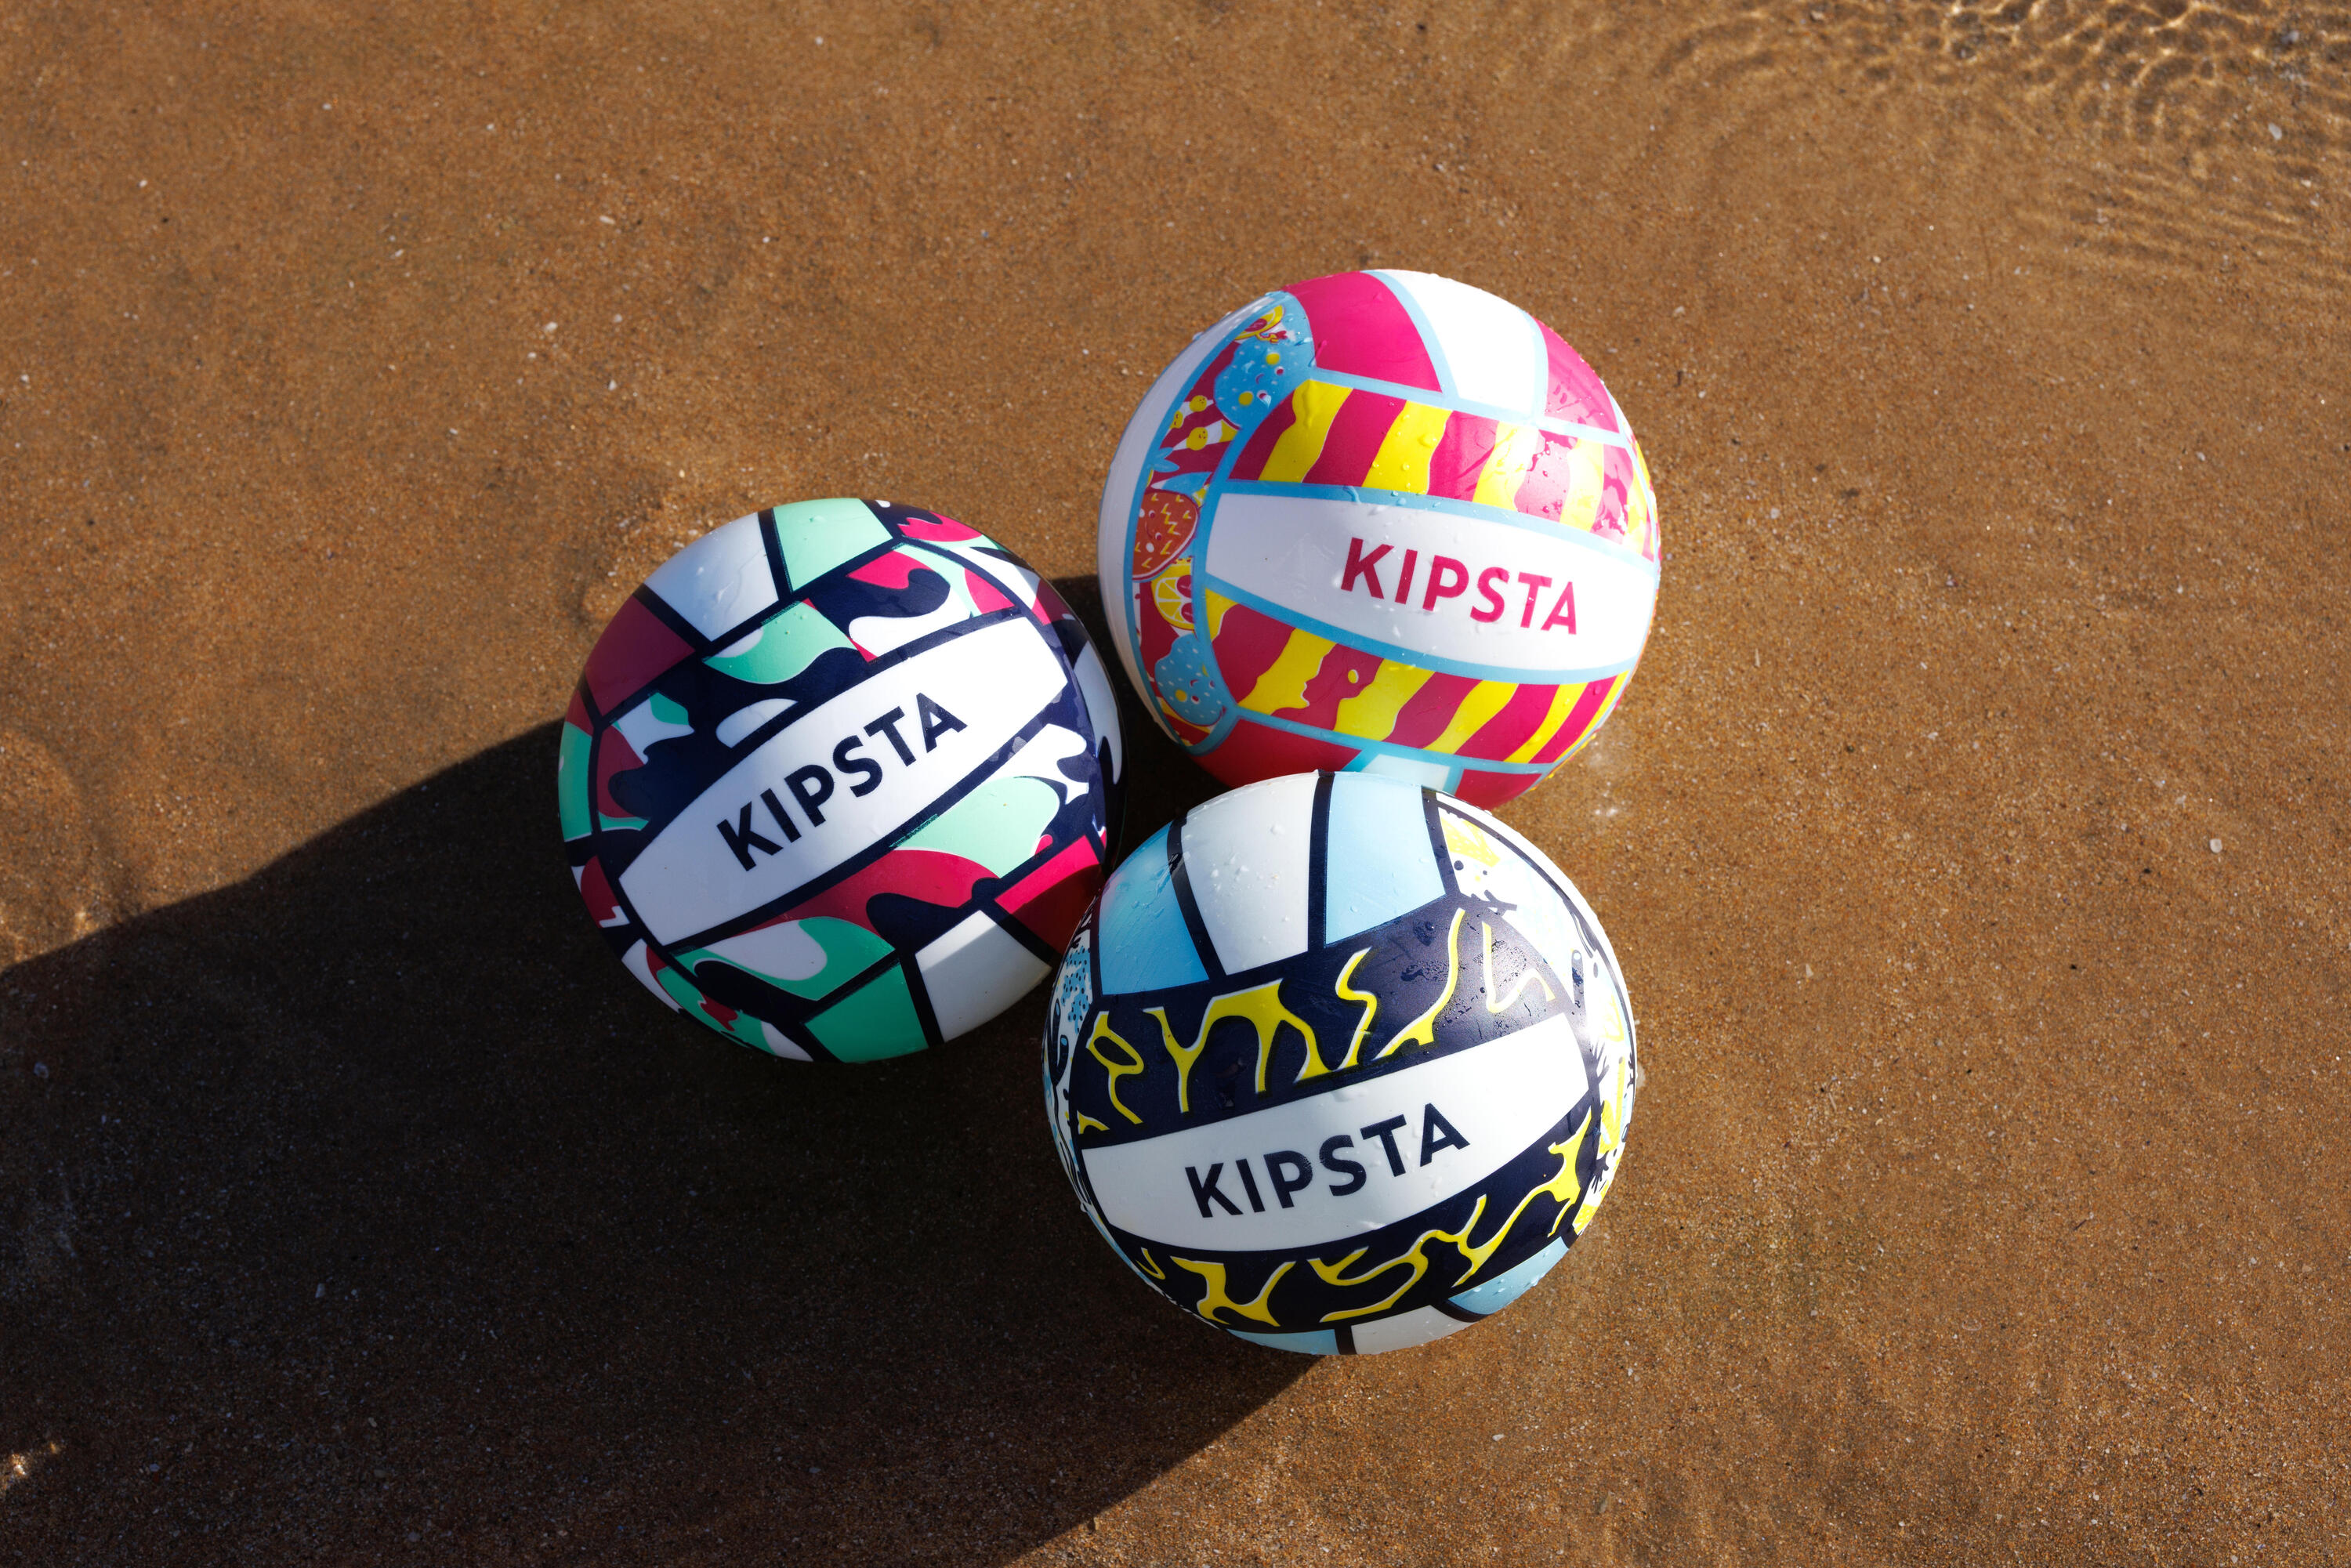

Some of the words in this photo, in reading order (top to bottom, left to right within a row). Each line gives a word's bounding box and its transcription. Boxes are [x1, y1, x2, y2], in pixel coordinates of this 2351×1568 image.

[1341, 538, 1577, 634] KIPSTA
[716, 692, 967, 871] KIPSTA
[1185, 1103, 1470, 1219] KIPSTA
